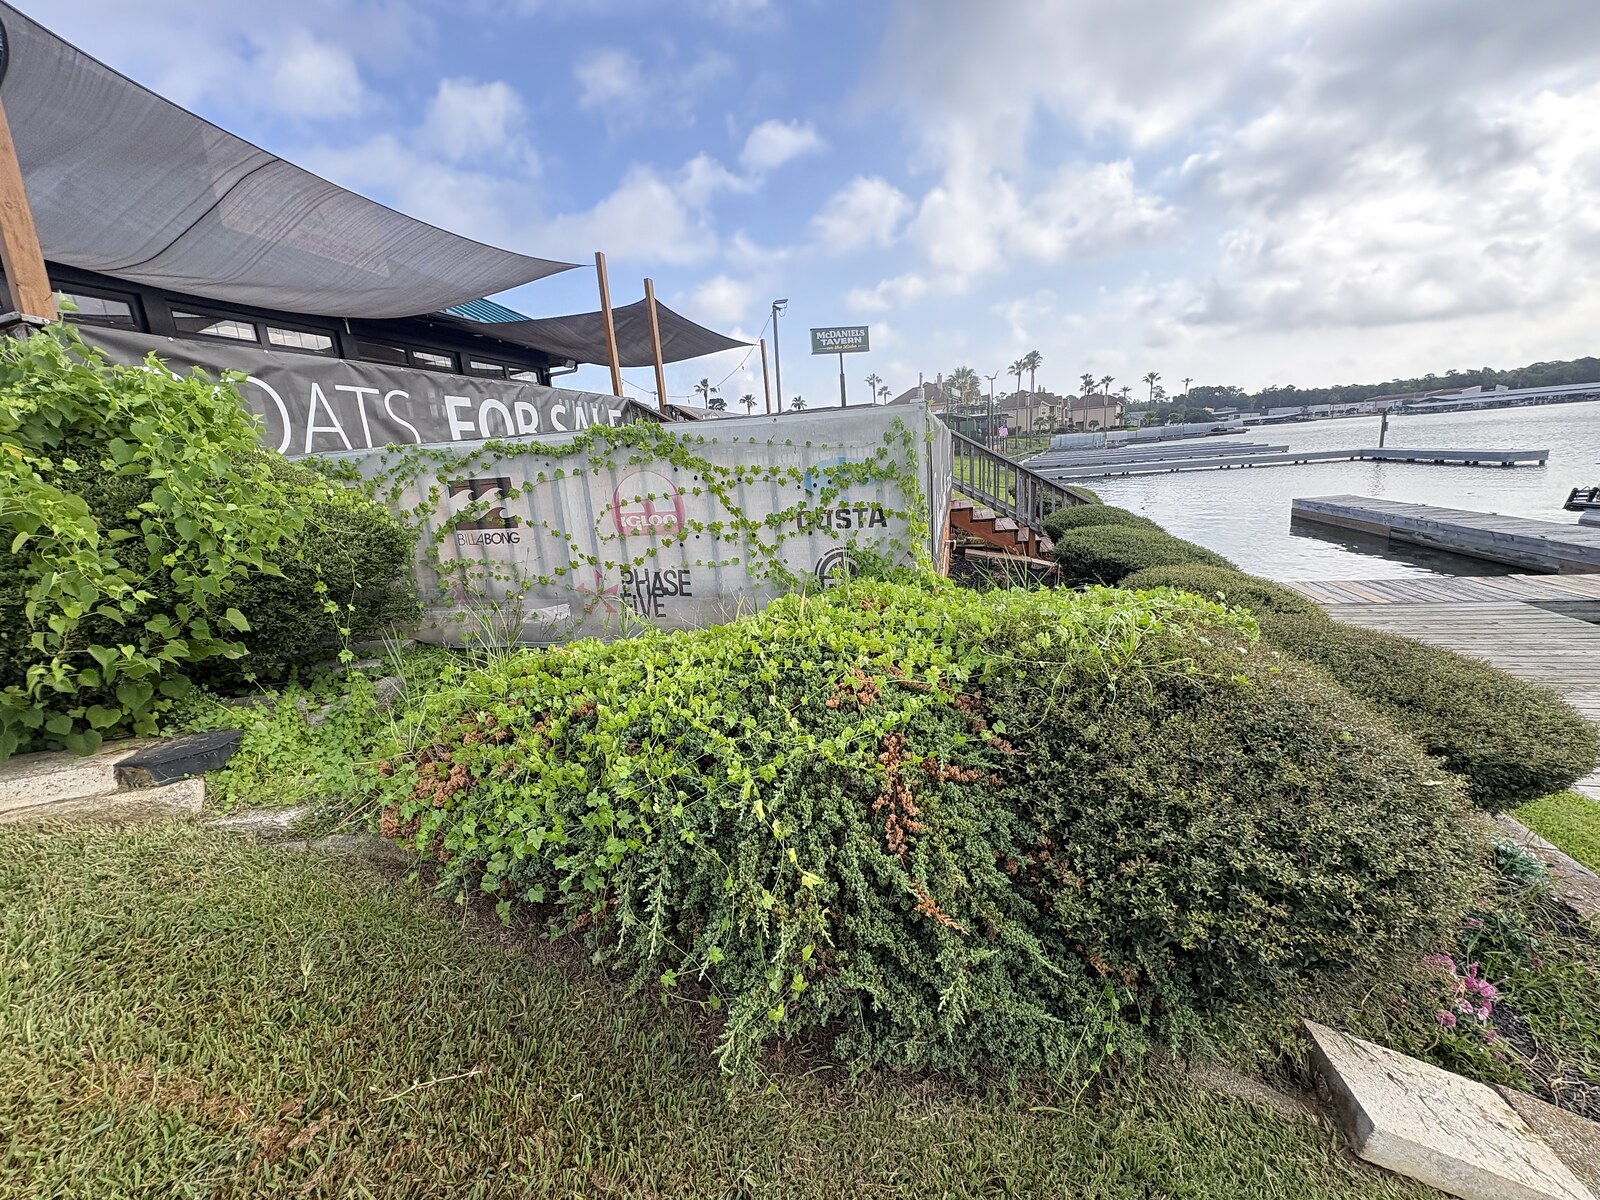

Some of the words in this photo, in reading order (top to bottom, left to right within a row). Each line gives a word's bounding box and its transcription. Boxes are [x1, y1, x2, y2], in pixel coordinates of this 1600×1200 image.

[816, 330, 865, 340] McDANIELS
[820, 337, 862, 346] TAVERN
[444, 395, 539, 440] FOR
[621, 514, 677, 530] IGLOO
[457, 531, 520, 546] BILLABONG
[620, 569, 692, 597] PHASE
